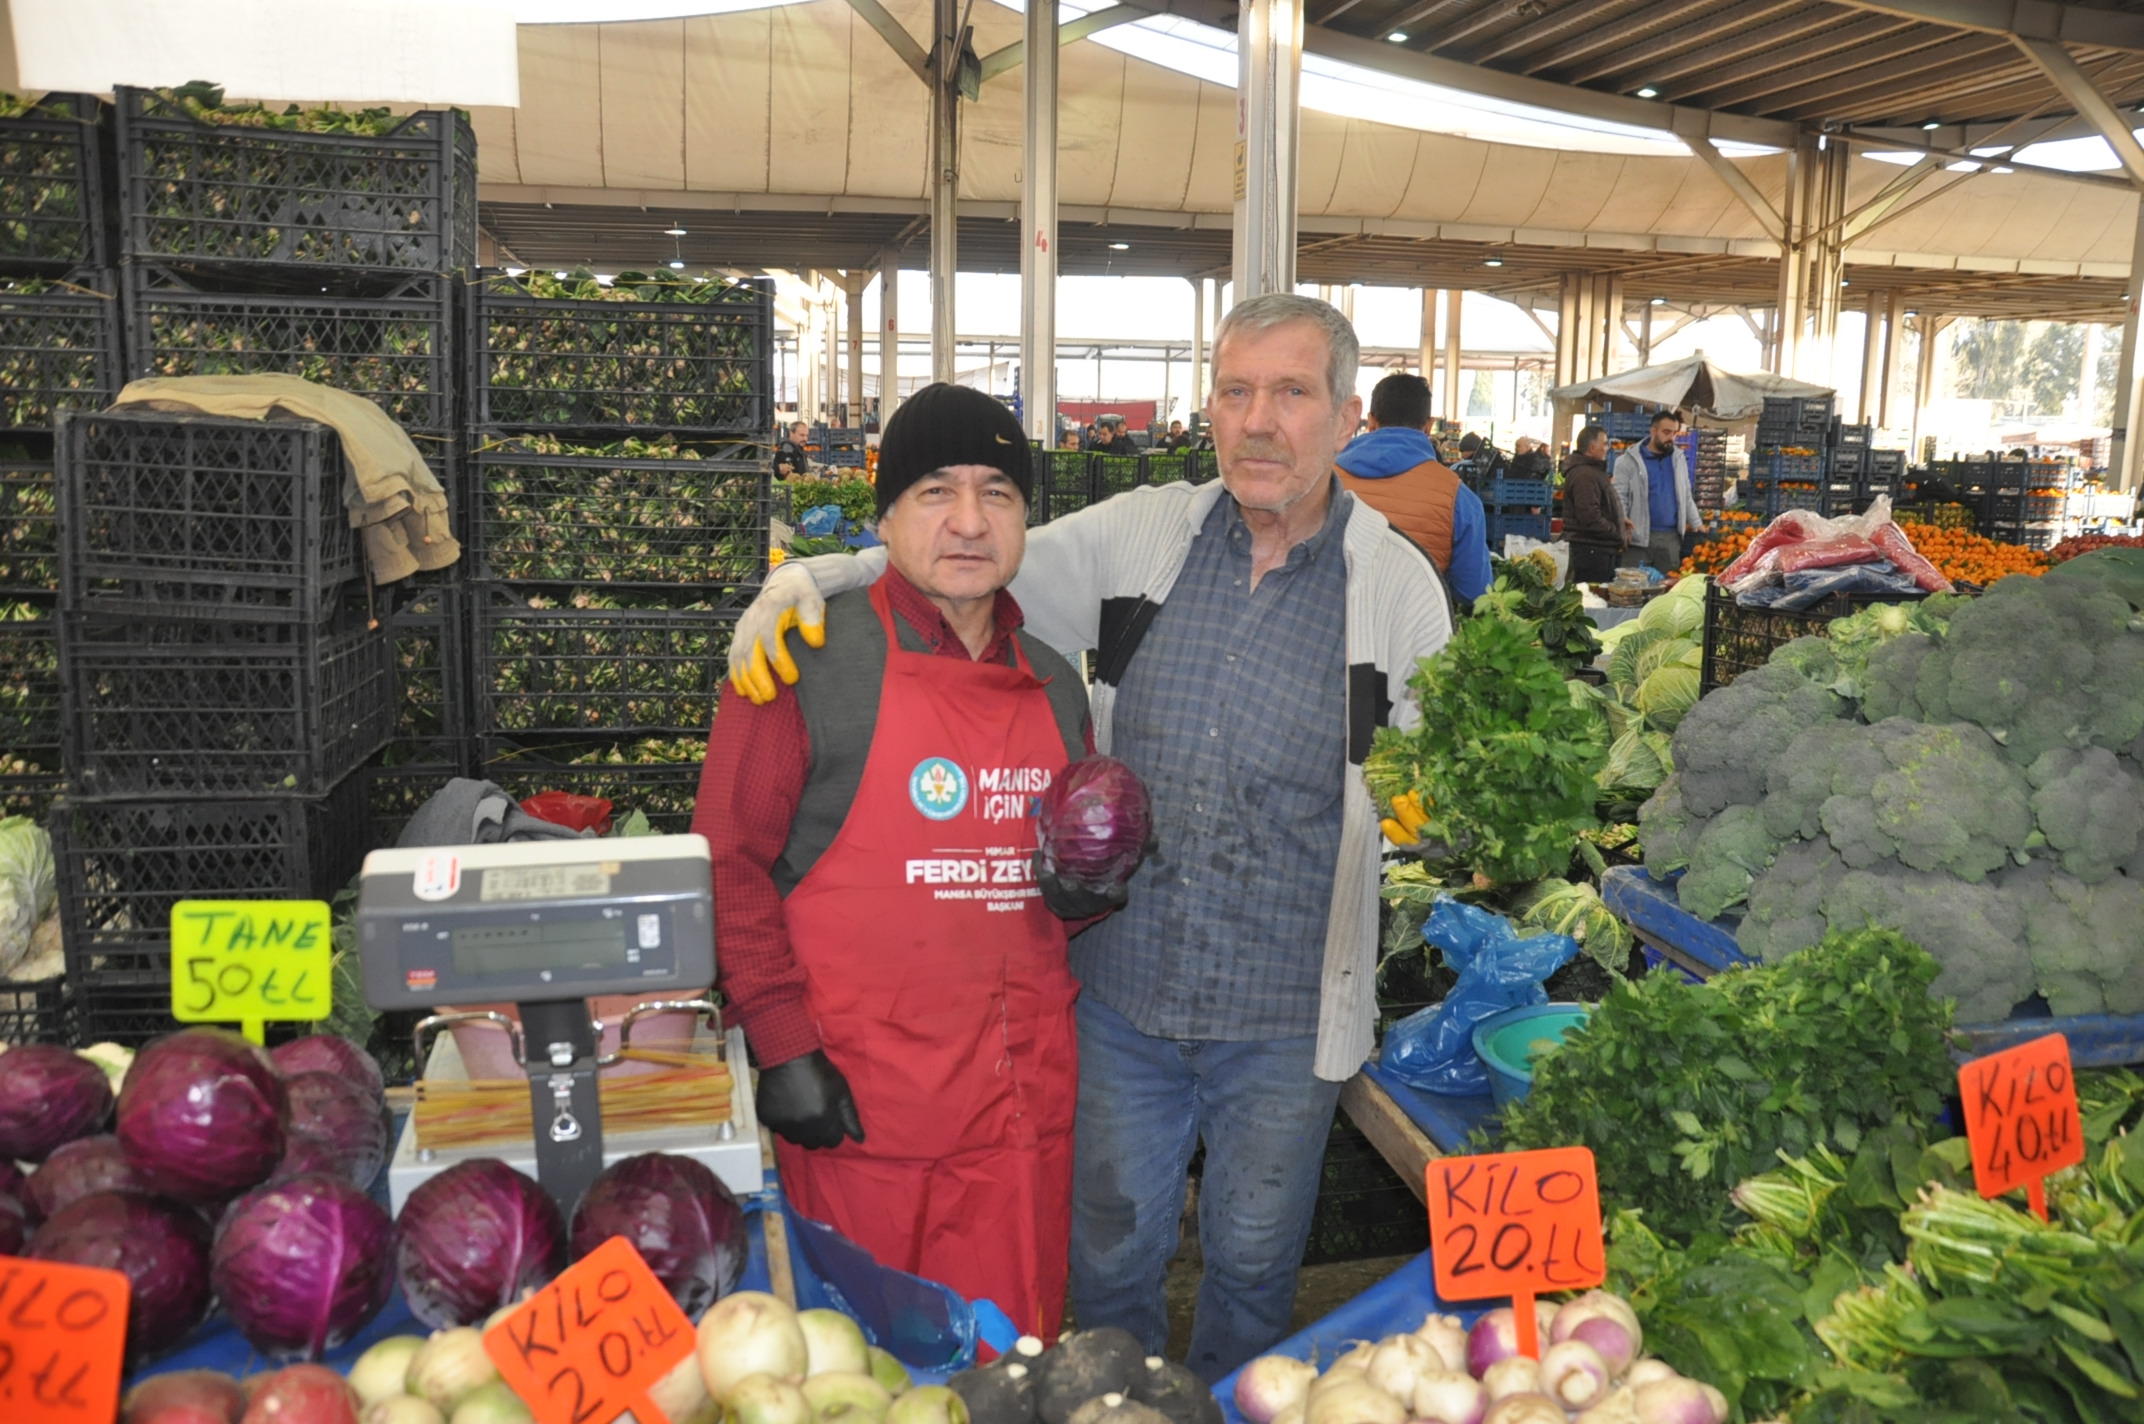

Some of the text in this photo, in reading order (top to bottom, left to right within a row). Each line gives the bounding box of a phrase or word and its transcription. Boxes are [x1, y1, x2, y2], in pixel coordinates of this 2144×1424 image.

[1035, 230, 1048, 253] 4
[990, 859, 1037, 883] ZEY
[183, 911, 322, 950] TANE
[0, 1267, 109, 1332] İLO
